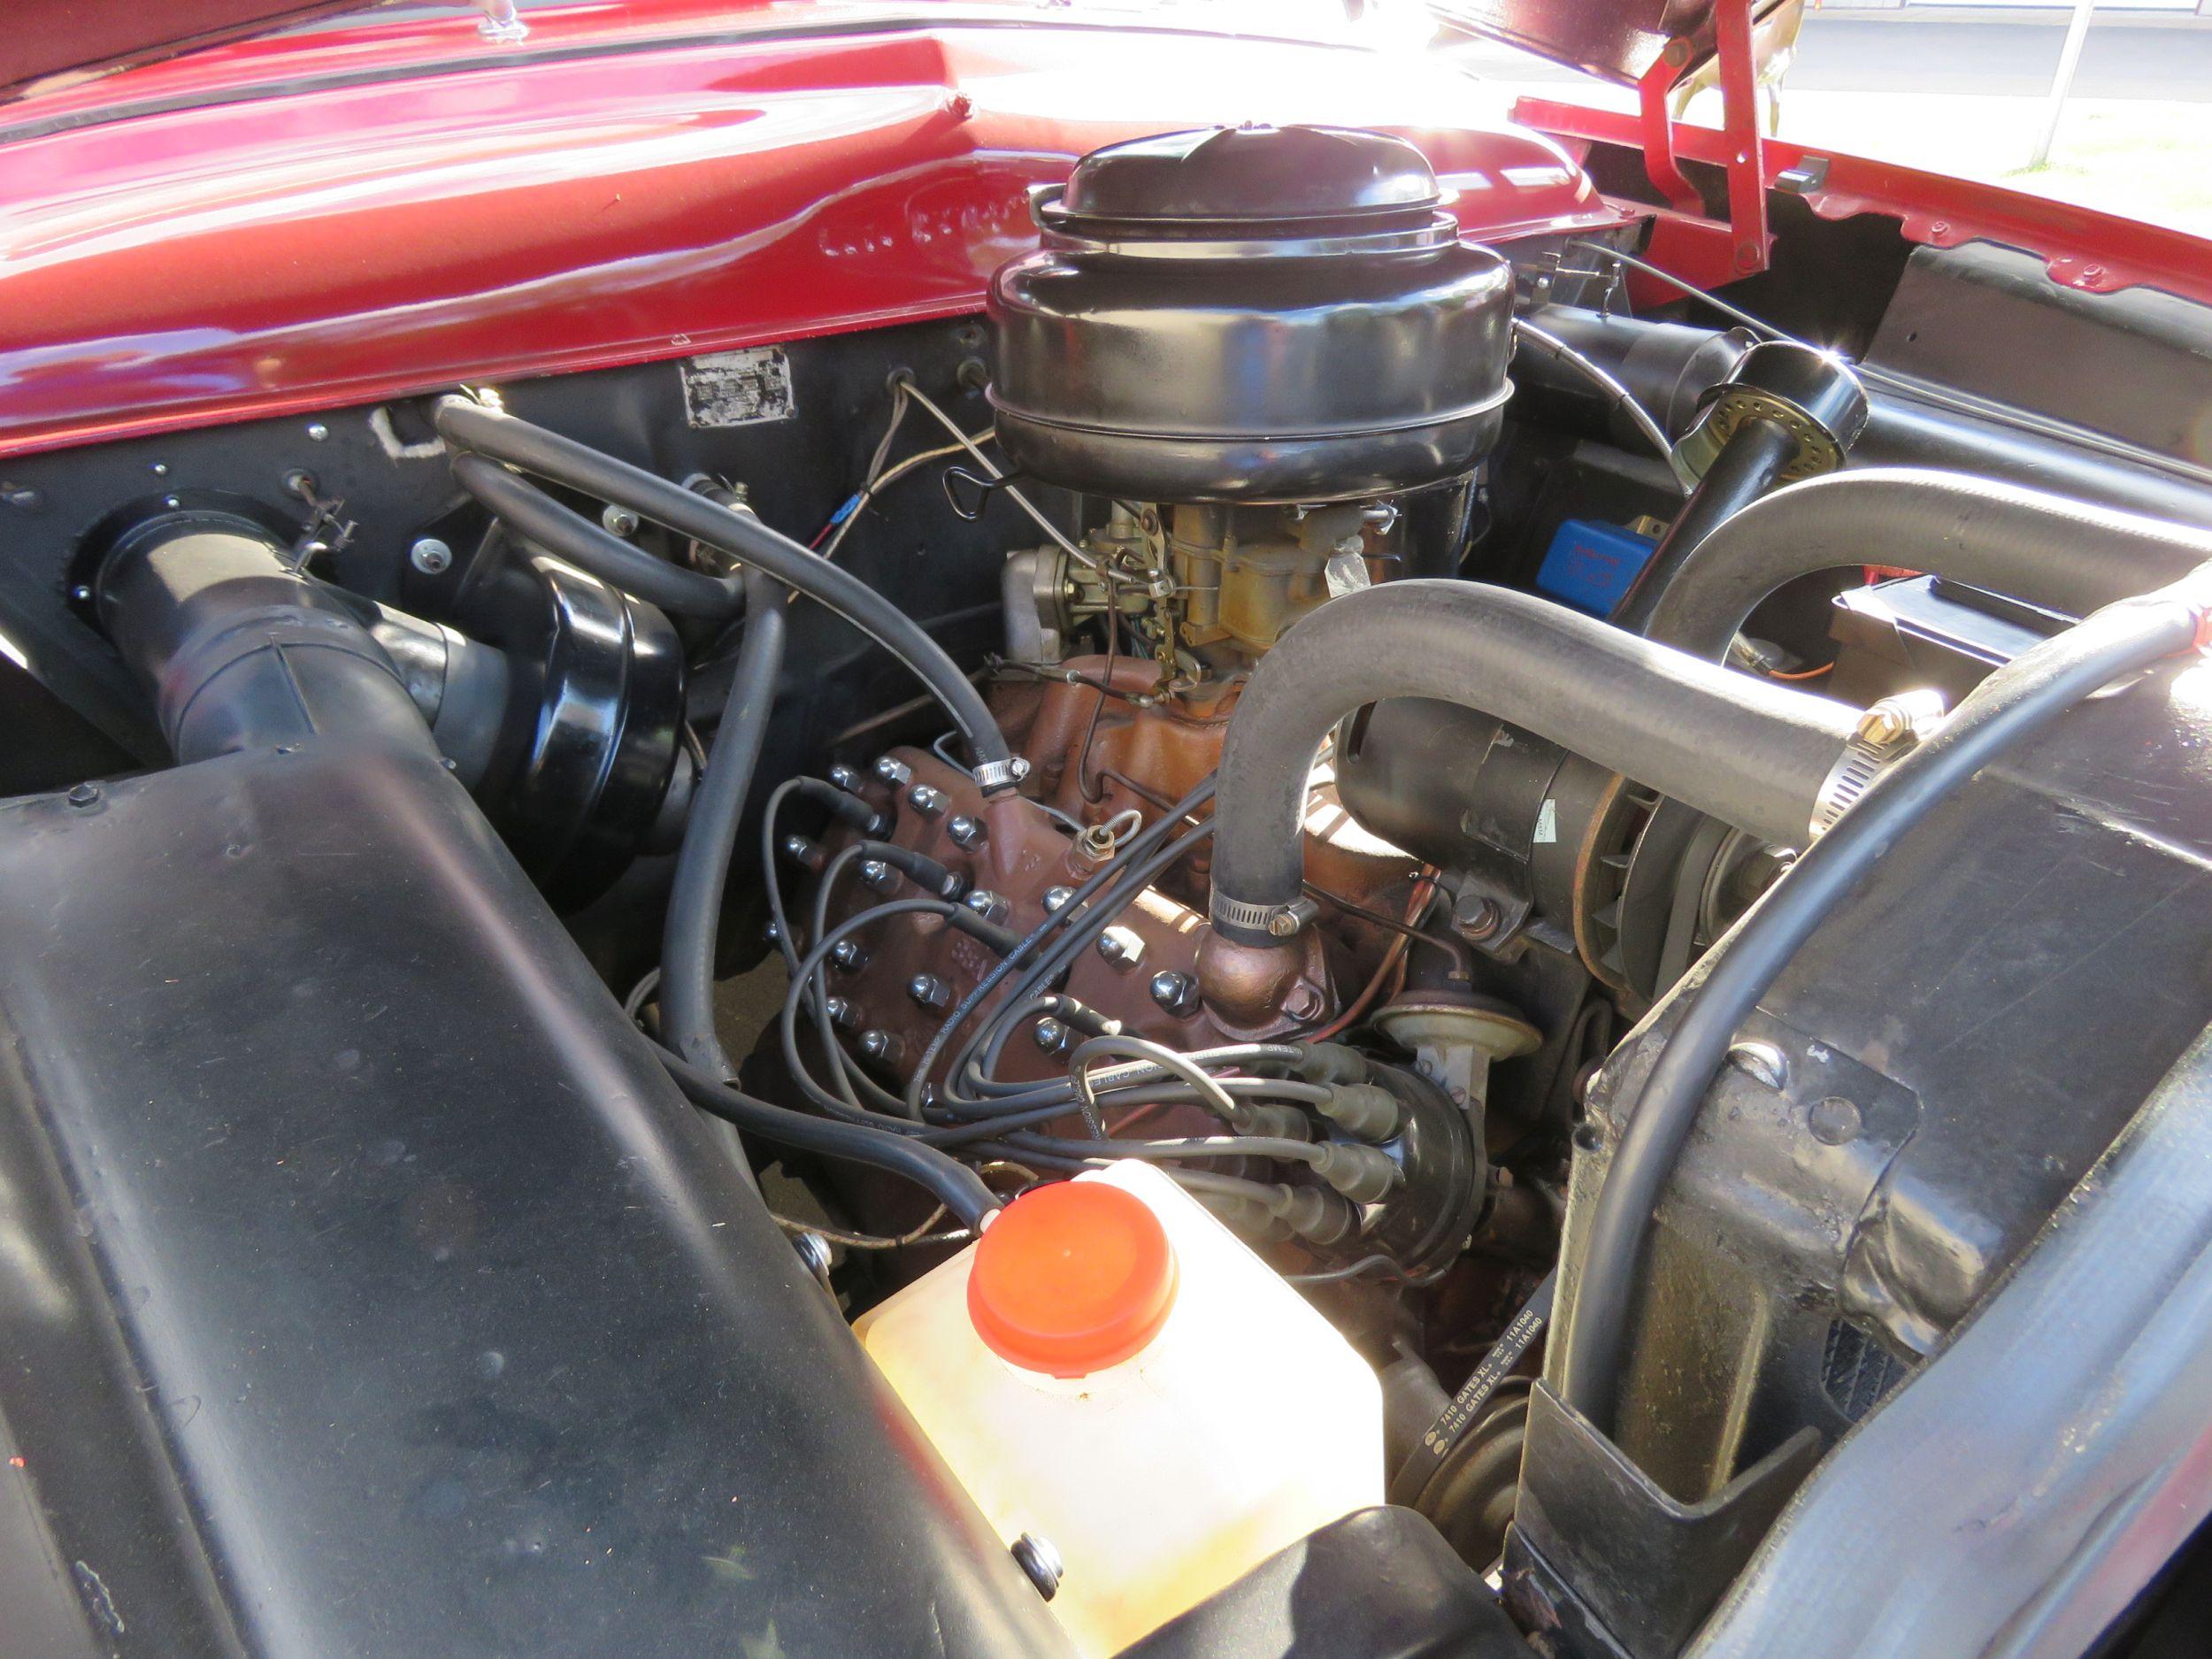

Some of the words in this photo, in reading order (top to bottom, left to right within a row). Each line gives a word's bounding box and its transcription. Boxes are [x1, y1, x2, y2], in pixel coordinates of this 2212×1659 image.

[941, 1010, 961, 1033] RADIO
[1440, 1406, 1457, 1425] 7410
[1456, 1376, 1481, 1403] GATES
[1506, 1310, 1534, 1341] 11A1040
[1448, 1413, 1466, 1433] 7410
[1465, 1384, 1489, 1412] GATES
[1514, 1317, 1543, 1349] 11A1040
